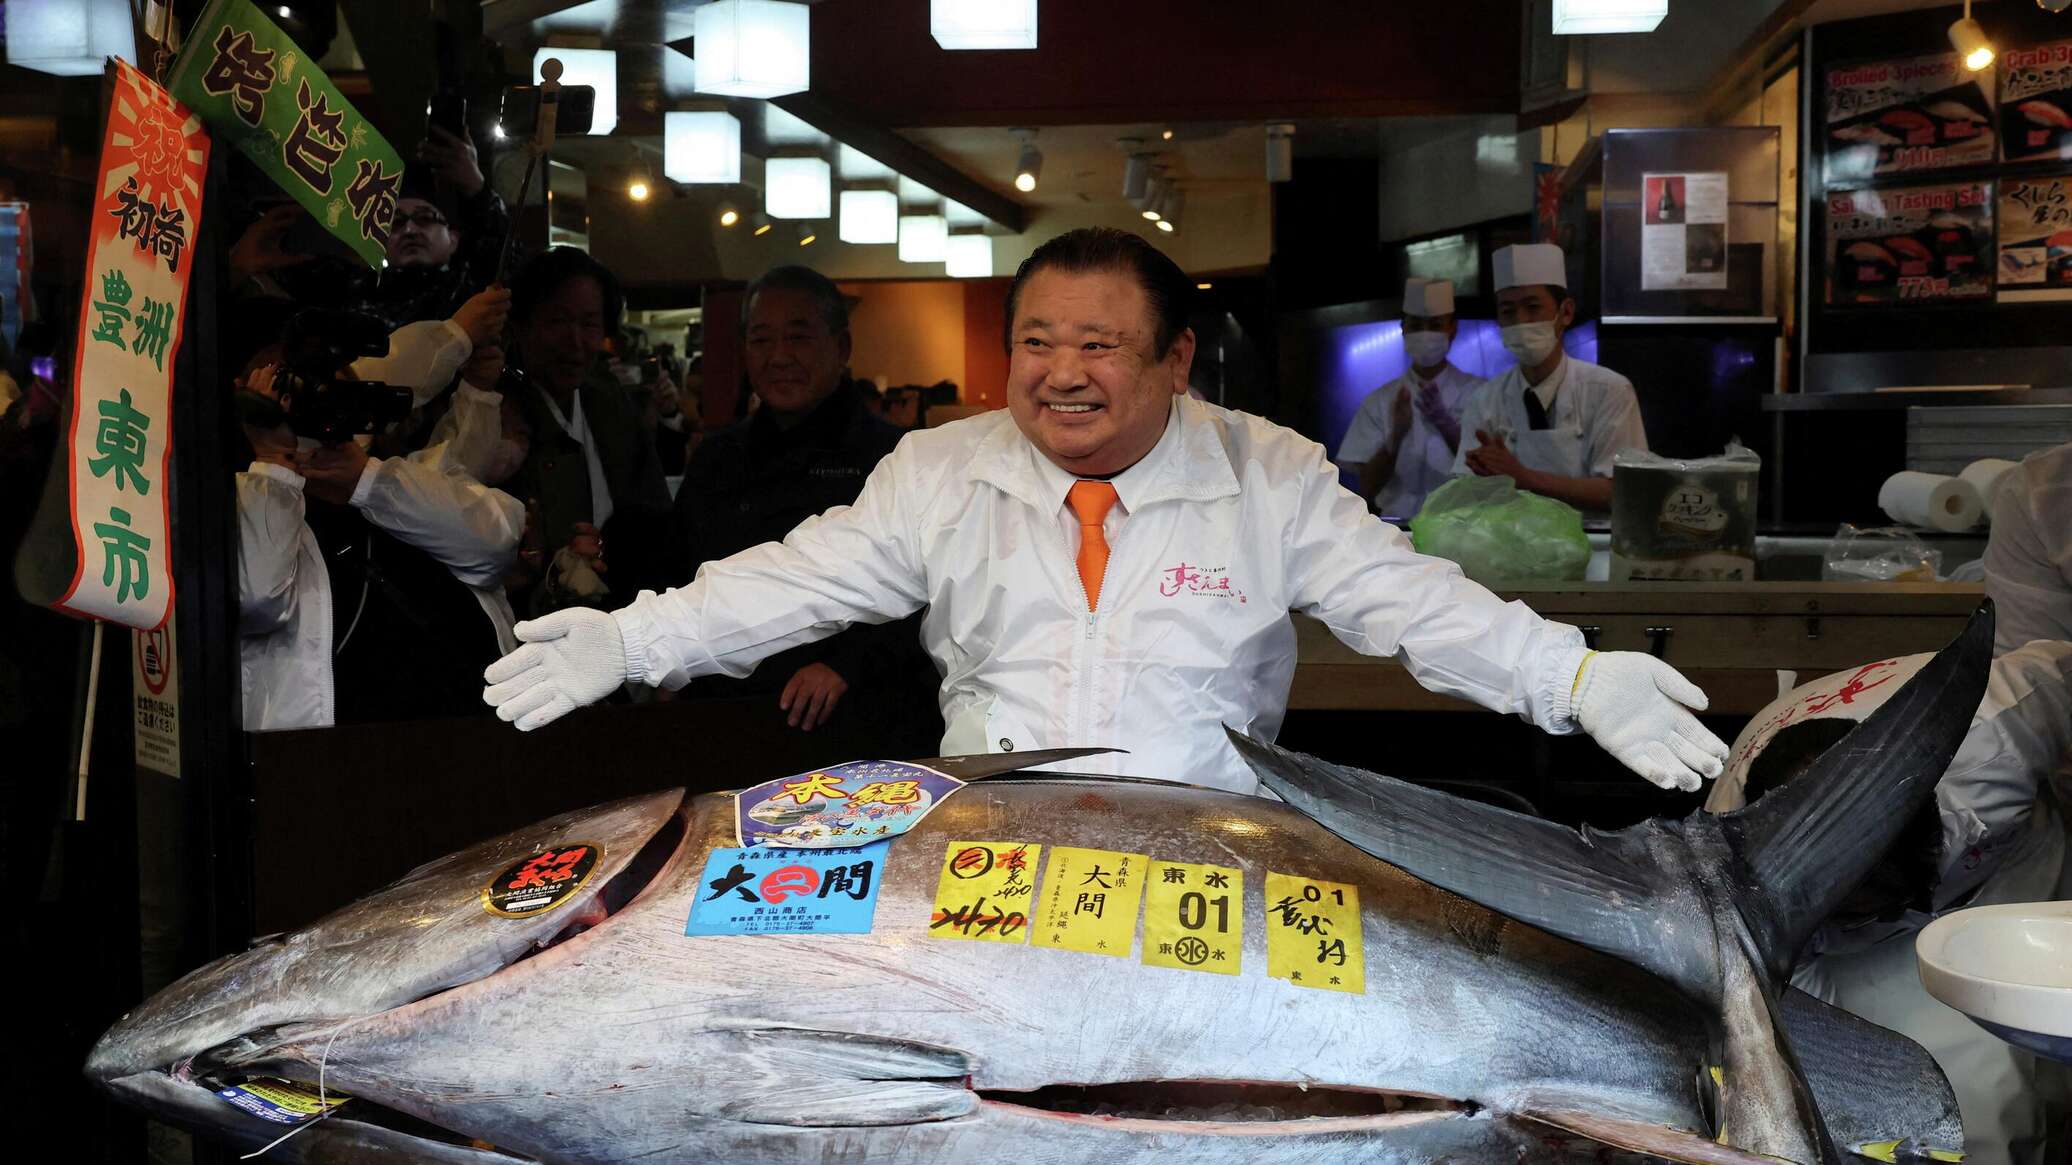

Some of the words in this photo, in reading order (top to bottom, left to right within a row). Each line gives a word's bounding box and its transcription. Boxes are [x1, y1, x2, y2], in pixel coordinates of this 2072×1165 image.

[2006, 50, 2049, 68] Crab
[1831, 197, 1888, 216] Saln
[1894, 191, 1954, 210] Tasting
[92, 269, 174, 372] 豊洲
[88, 388, 150, 604] 東市
[1114, 857, 1131, 888] 青森県
[1162, 867, 1229, 888] 東水
[1074, 864, 1113, 919] 大間
[1303, 885, 1344, 906] 01
[1179, 892, 1228, 933] 01
